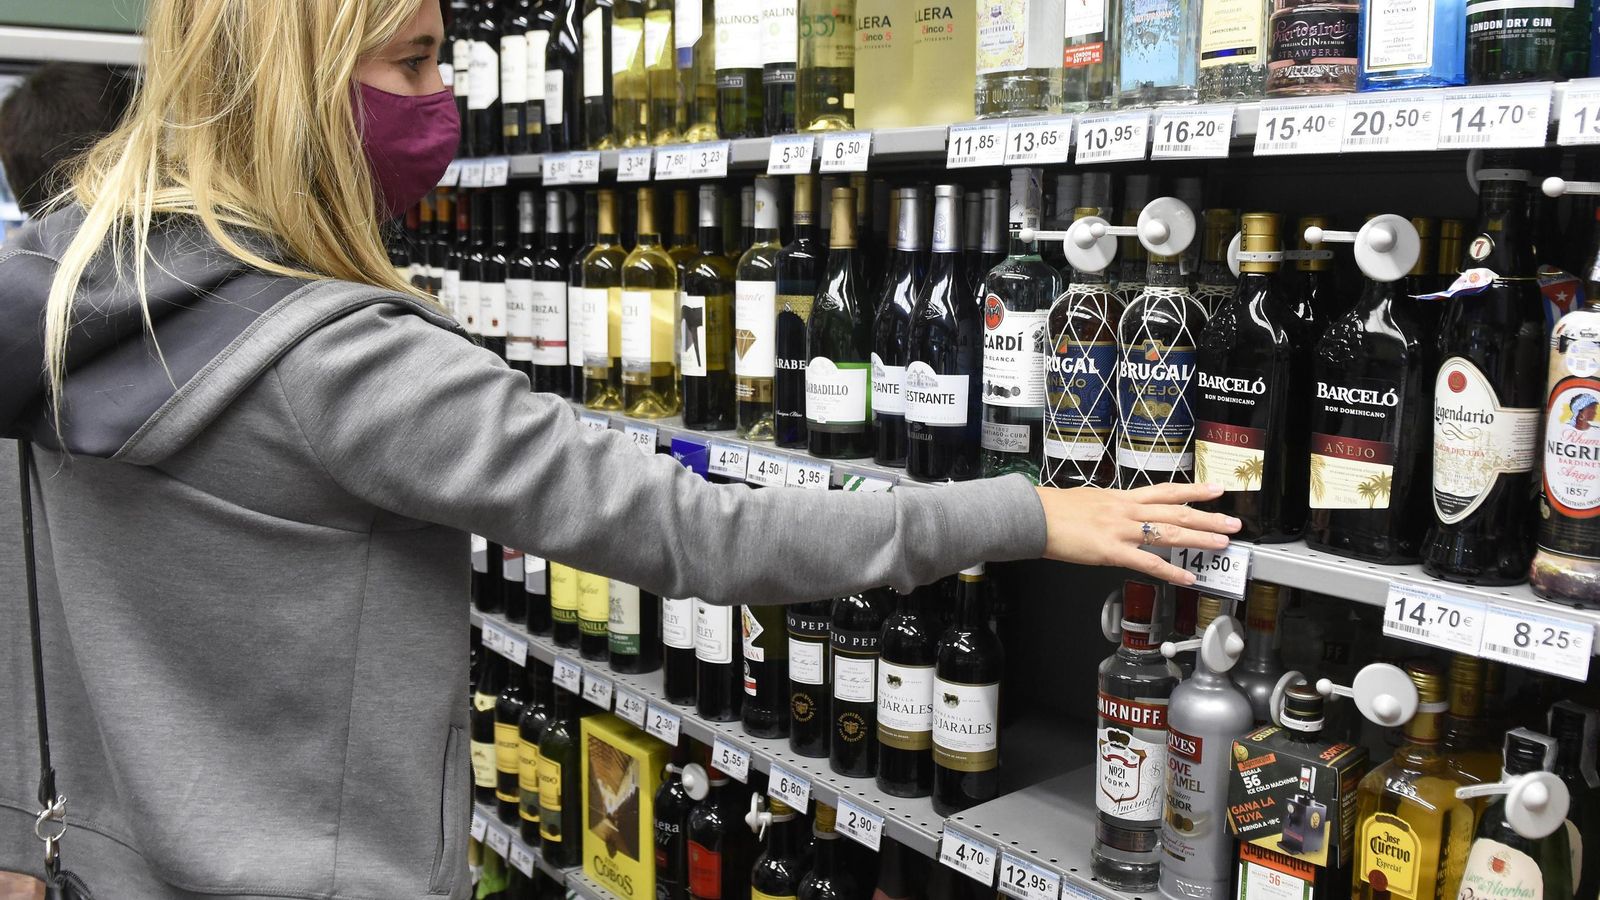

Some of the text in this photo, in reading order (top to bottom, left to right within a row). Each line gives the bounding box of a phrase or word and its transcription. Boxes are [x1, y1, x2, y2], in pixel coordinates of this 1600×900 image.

[1470, 18, 1552, 33] LONDON DRY GIN
[1300, 38, 1321, 46] GIN
[1265, 114, 1337, 141] 15,40€
[1350, 109, 1433, 136] 20,50€
[1163, 120, 1225, 143] 16,20€
[1475, 241, 1485, 257] 7
[1120, 360, 1191, 381] BRUGAL
[1128, 382, 1179, 396] AÑEJO
[1198, 372, 1266, 395] BARCELÓ
[1205, 393, 1255, 406] RON DOMINICANO
[1316, 382, 1398, 407] BARCELÓ
[1325, 405, 1386, 419] RON DOMINICANO
[1206, 426, 1249, 444] AÑEJO
[1325, 441, 1376, 459] AÑEJO
[1566, 487, 1589, 497] 1857
[1179, 548, 1240, 573] 14,50€
[1394, 598, 1474, 628] 14,70€
[1514, 622, 1585, 650] 8,25€
[882, 699, 934, 715] JARALES
[938, 718, 992, 734] JARALES
[1240, 767, 1262, 777] REGALA
[1104, 776, 1130, 788] VODKA
[1243, 774, 1262, 789] 56
[1247, 776, 1299, 795] ICE COLD MACHINES
[1231, 796, 1276, 815] GANA LA
[1237, 811, 1264, 824] TUYA
[1242, 823, 1263, 832] BRINDA
[1384, 831, 1401, 845] Jose
[956, 843, 990, 865] 4,70€
[1370, 835, 1410, 863] Cuervo
[1376, 857, 1402, 873] Especial
[1006, 865, 1053, 892] 12,95€
[1269, 873, 1281, 886] 56
[1487, 879, 1535, 898] Hierbas
